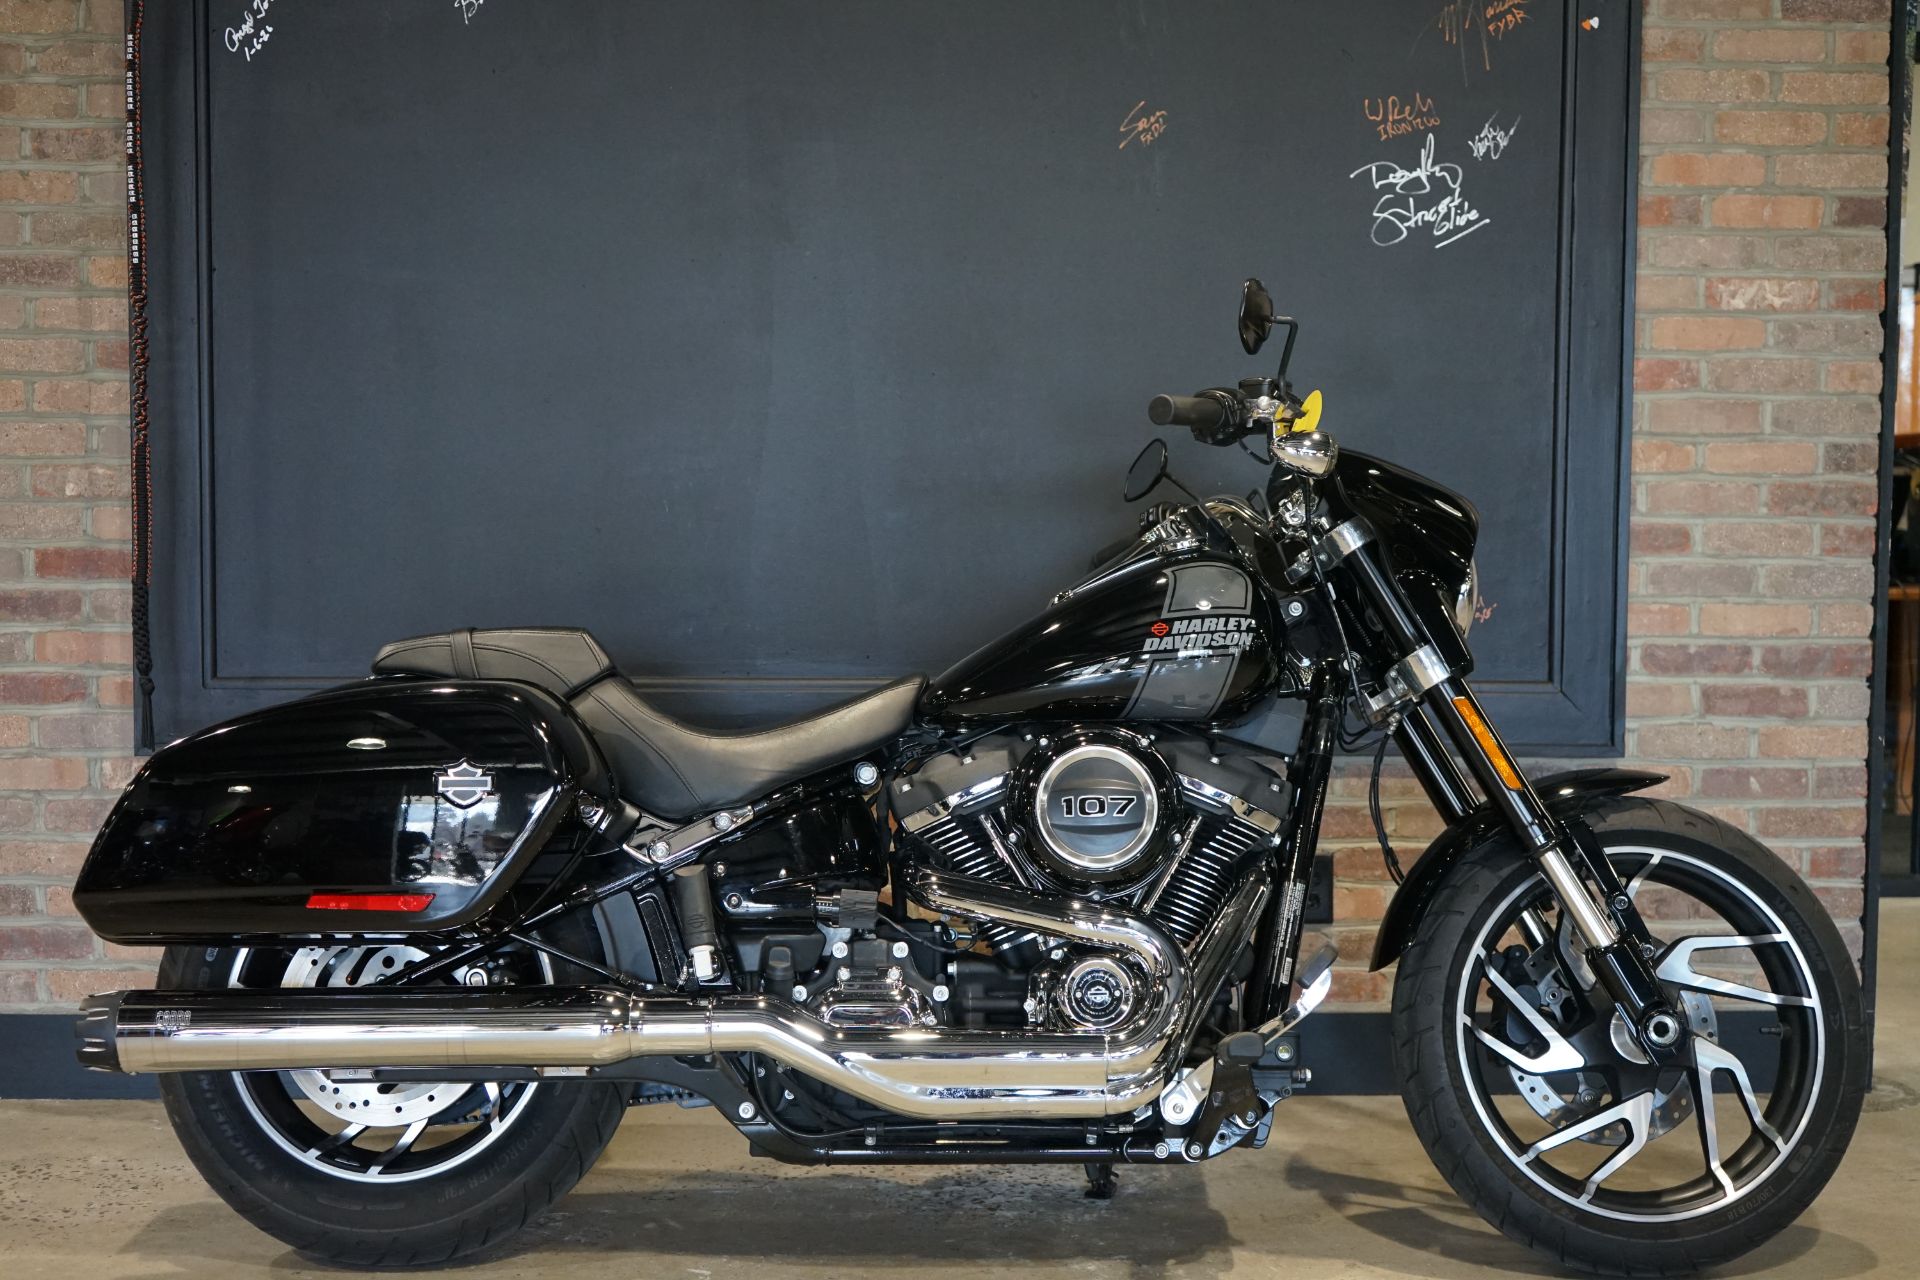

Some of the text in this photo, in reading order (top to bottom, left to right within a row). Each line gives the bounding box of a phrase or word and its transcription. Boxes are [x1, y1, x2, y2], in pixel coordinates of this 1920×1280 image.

[1143, 631, 1254, 651] DAVIDSON
[1061, 795, 1137, 818] 107
[197, 1072, 265, 1171] MICHELIN
